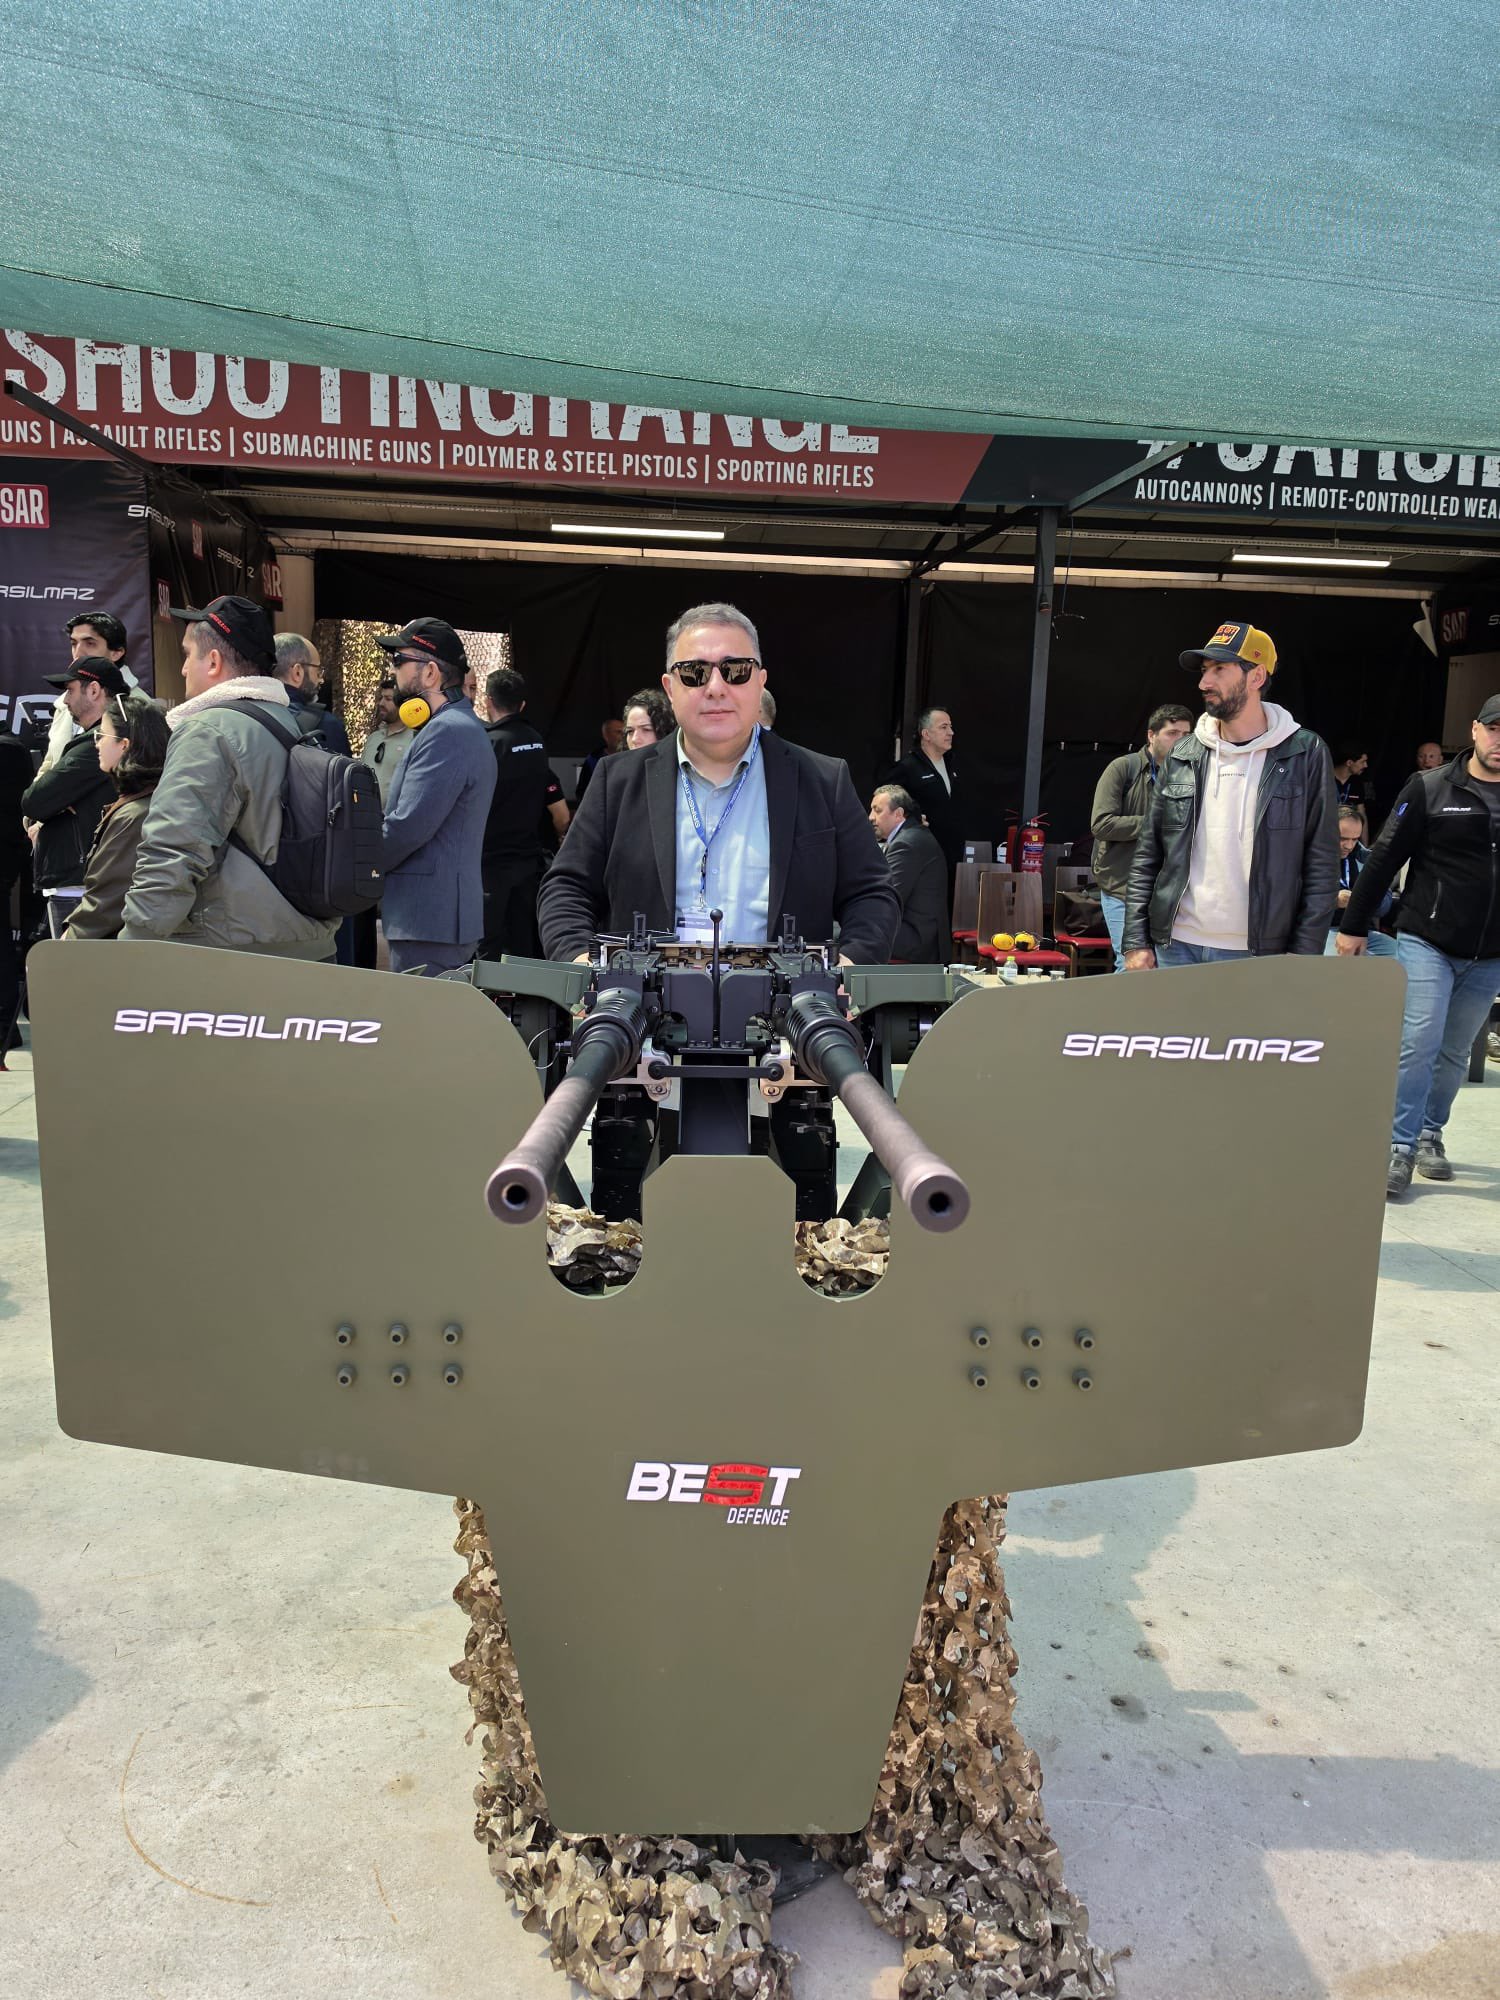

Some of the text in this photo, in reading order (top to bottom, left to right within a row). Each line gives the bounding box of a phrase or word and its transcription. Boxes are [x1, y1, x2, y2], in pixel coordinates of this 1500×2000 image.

[155, 427, 222, 452] RIFLES
[242, 431, 432, 464] SUBMACHINE GUNS
[452, 444, 697, 479] POLYMER & STEEL PISTOLS
[717, 458, 874, 487] SPORTING RIFLES
[0, 487, 44, 524] SAR
[1135, 478, 1264, 505] AUTOCANNONS
[1281, 486, 1500, 519] REMOTE-CONTROLLED WEA
[261, 564, 283, 597] SAR
[114, 1009, 381, 1044] SARSILMAZ
[1062, 1034, 1325, 1063] SARSILMAZ
[626, 1461, 801, 1506] BEST
[727, 1507, 790, 1526] DEFENCE
